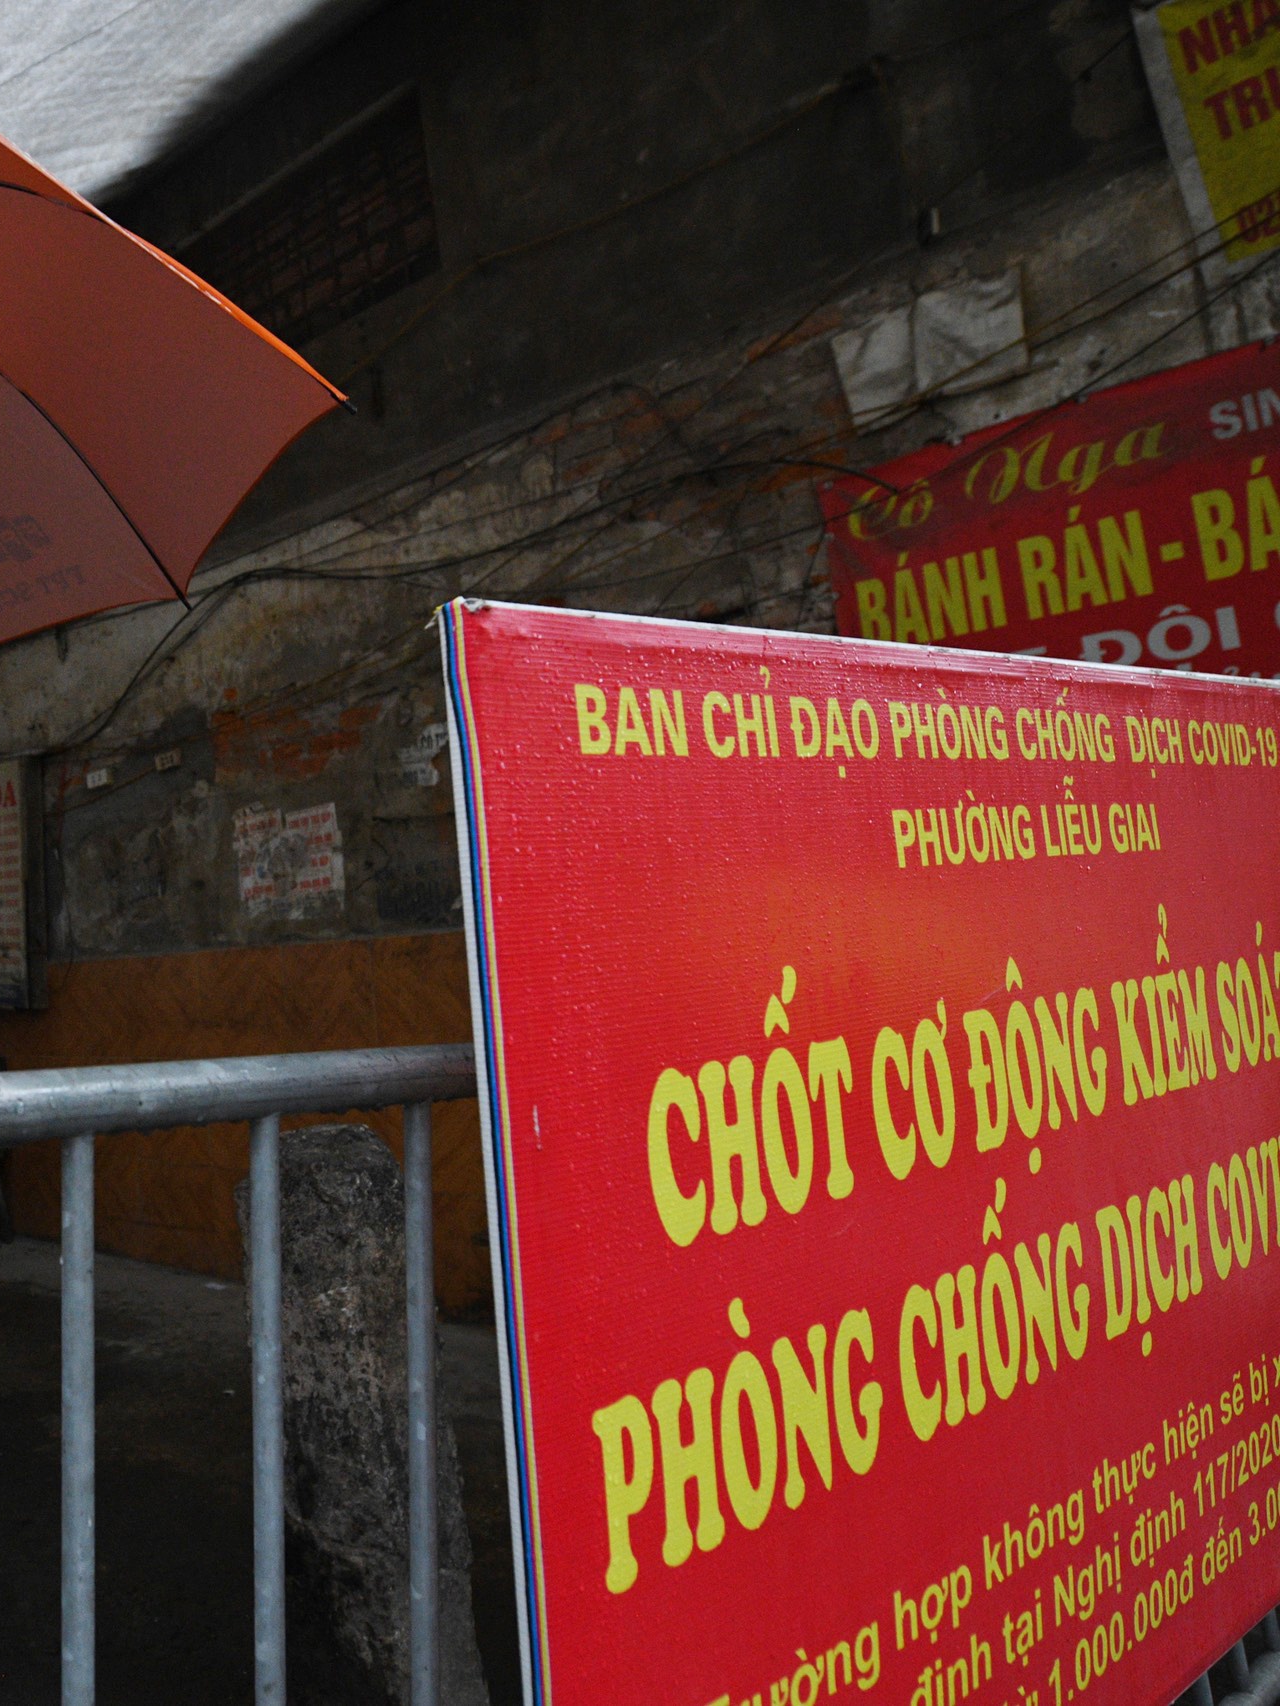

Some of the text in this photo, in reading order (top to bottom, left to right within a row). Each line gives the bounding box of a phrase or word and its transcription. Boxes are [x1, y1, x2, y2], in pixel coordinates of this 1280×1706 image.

[964, 422, 1170, 505] Nga
[855, 547, 1008, 644] BÁNH
[1018, 505, 1154, 621] RÁN
[1080, 603, 1242, 666] ĐÔI
[574, 666, 1278, 778] BAN CHỈ ĐẠO PHÒNG CHỐNG DỊCH COVID-19
[891, 775, 1161, 869] PHƯỜNG LIỄU GIAI
[648, 903, 1280, 1247] CHỐT CƠ ĐỘNG KIỂM SOÁ
[593, 1134, 1280, 1594] PHÒNG CHỐNG DỊCH COVI
[893, 1565, 973, 1651] hợp
[982, 1488, 1085, 1591] không
[1092, 1442, 1156, 1514] thực
[1162, 1402, 1214, 1466] hiện
[1220, 1370, 1244, 1425] sẽ
[1249, 1353, 1269, 1406] bị
[1002, 1588, 1044, 1667] tại
[1053, 1531, 1122, 1627] Nghị
[1130, 1508, 1186, 1568] định
[1193, 1413, 1280, 1518] 117/2020
[1048, 1553, 1194, 1706] 1.000.000đ
[1201, 1516, 1243, 1586] đến
